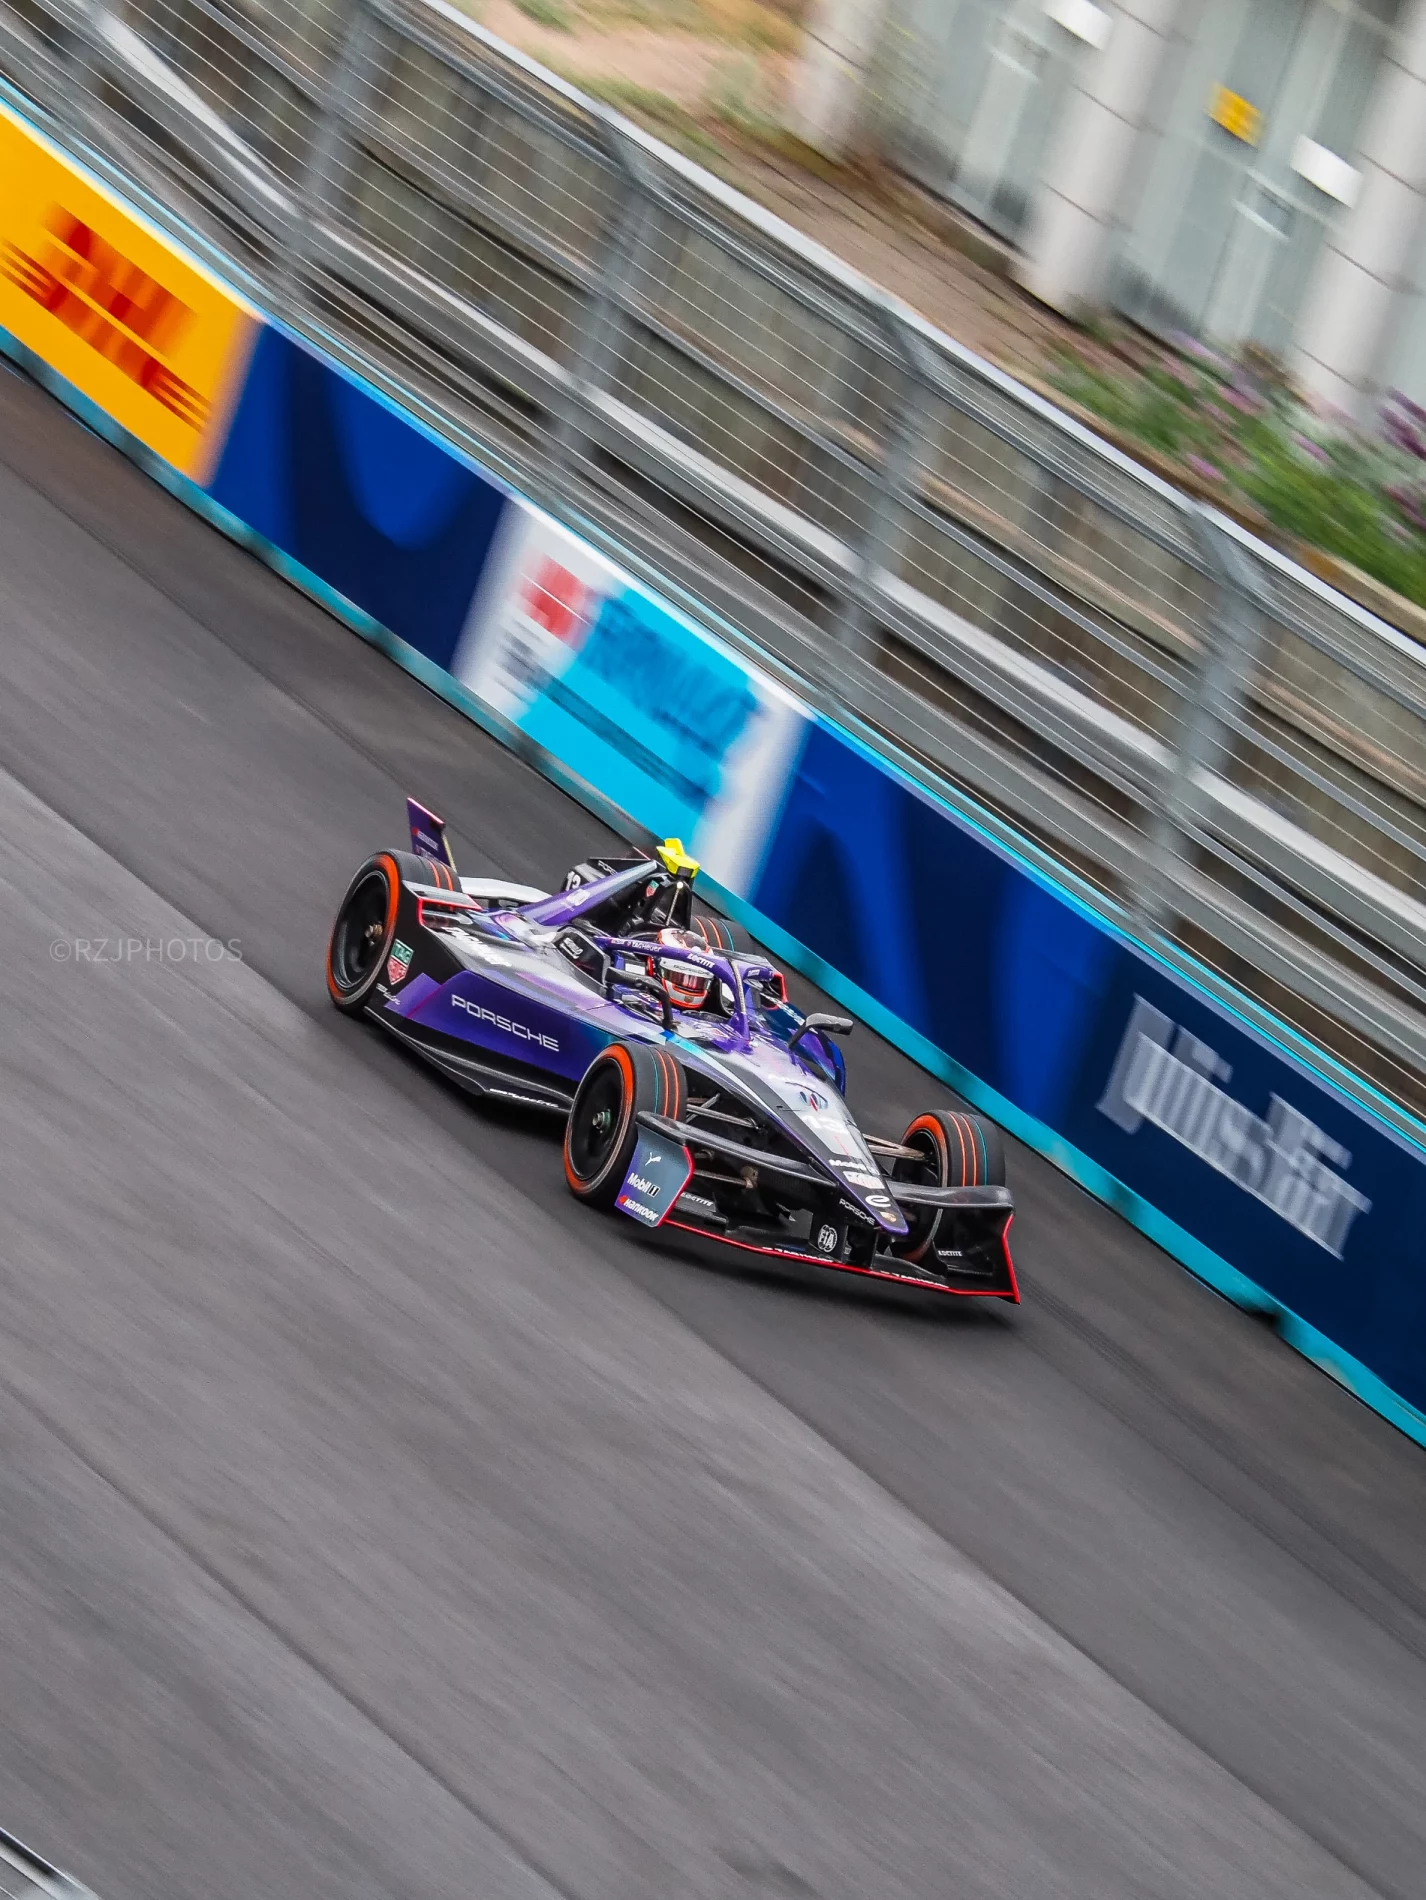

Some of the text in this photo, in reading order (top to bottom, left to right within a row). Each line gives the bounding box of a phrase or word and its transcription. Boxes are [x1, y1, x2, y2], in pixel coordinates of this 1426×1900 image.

[687, 953, 716, 969] LOCTITE
[451, 994, 560, 1052] PORSCHE
[627, 1172, 652, 1194] Mobil
[680, 1191, 714, 1207] LOCTITE
[838, 1198, 876, 1226] PORSCHE
[819, 1229, 838, 1250] FIA
